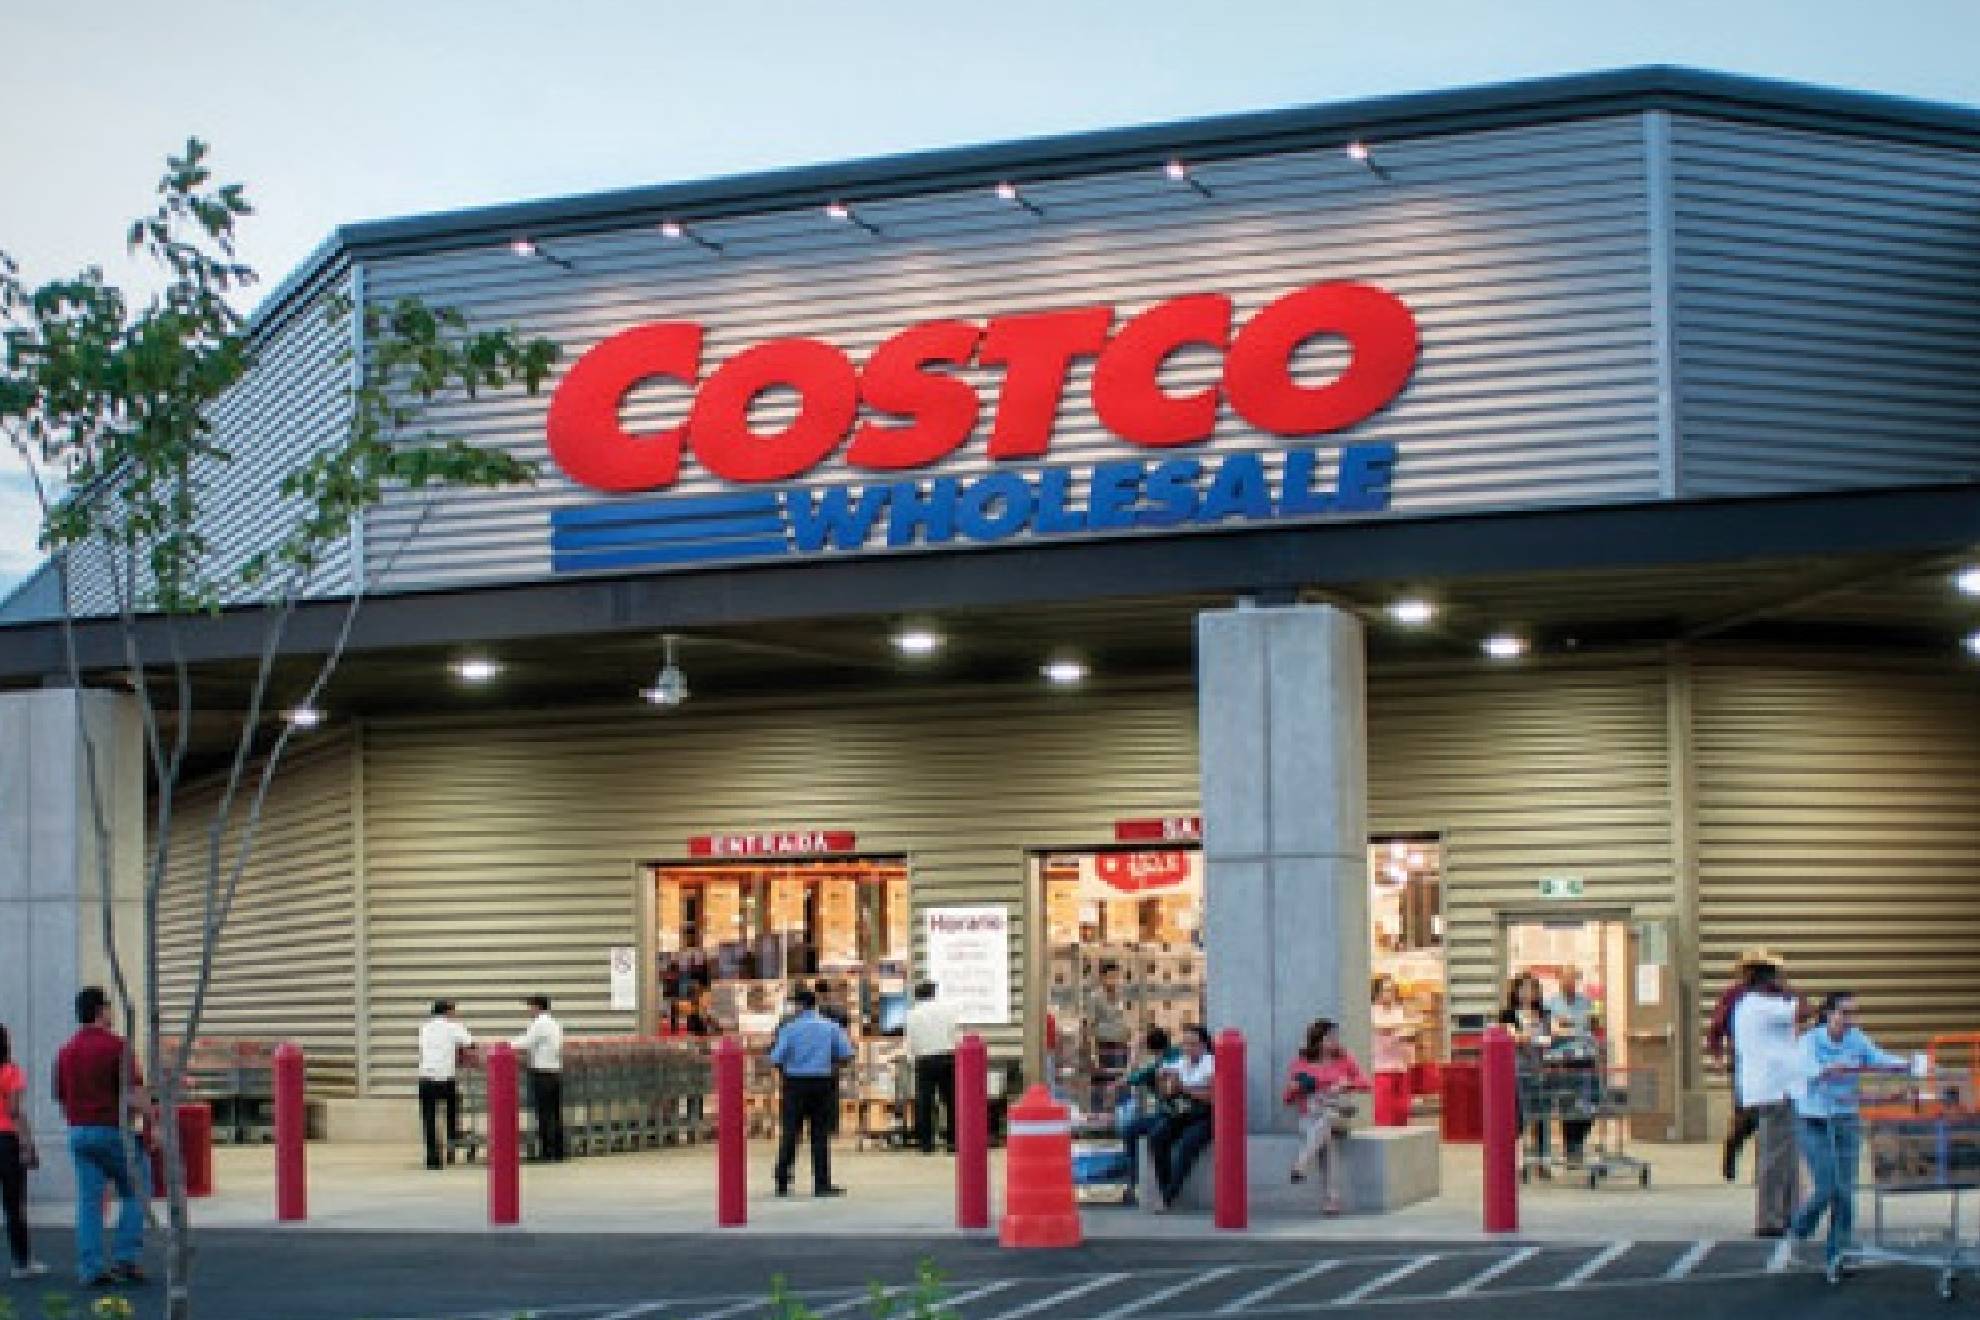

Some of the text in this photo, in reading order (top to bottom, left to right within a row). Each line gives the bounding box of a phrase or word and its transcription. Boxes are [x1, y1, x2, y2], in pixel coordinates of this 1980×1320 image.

[547, 280, 1420, 491] COSTCO
[786, 442, 1398, 554] WHOLESALE
[711, 830, 828, 856] ENTRADA
[1162, 816, 1202, 840] SA
